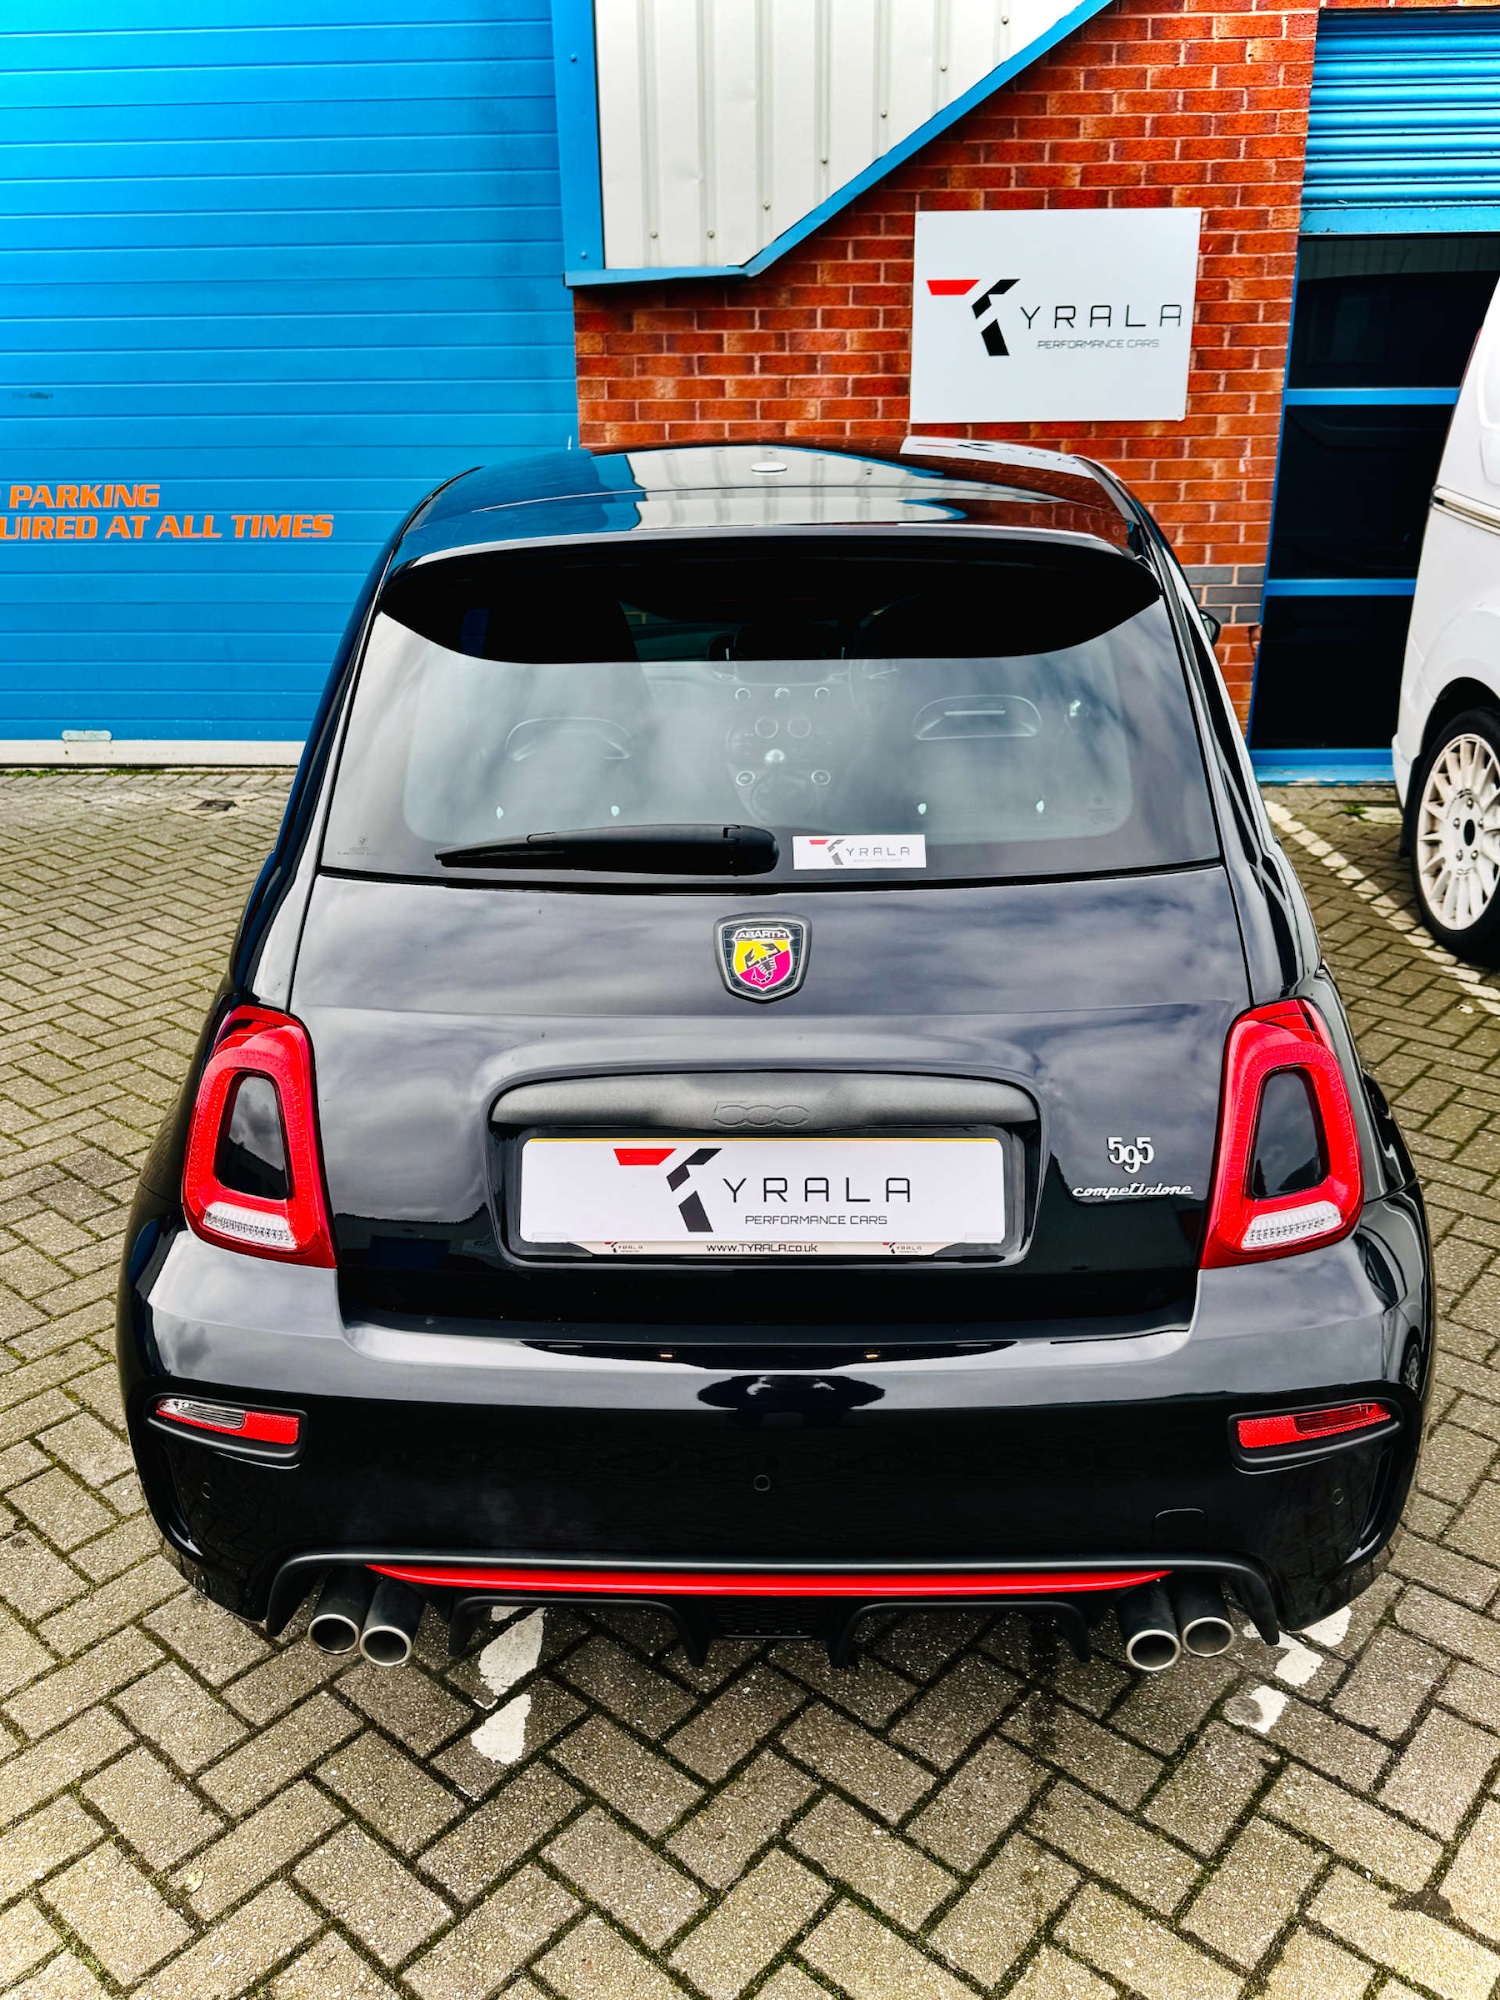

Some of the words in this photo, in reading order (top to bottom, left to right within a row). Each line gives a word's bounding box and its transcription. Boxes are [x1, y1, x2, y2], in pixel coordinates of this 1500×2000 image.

[1037, 339, 1125, 349] PERFORMANCE
[1127, 339, 1160, 348] CARS
[9, 484, 160, 508] PARKING
[105, 516, 150, 539] AT
[156, 515, 222, 538] ALL
[231, 514, 334, 538] TIMES
[738, 930, 787, 939] ABARTH
[1107, 1136, 1155, 1174] 595
[1072, 1182, 1194, 1199] competizione
[744, 1214, 846, 1226] PERFORMANCE
[849, 1214, 888, 1226] CARS
[706, 1243, 818, 1253] www.TYRALA.co.uk
